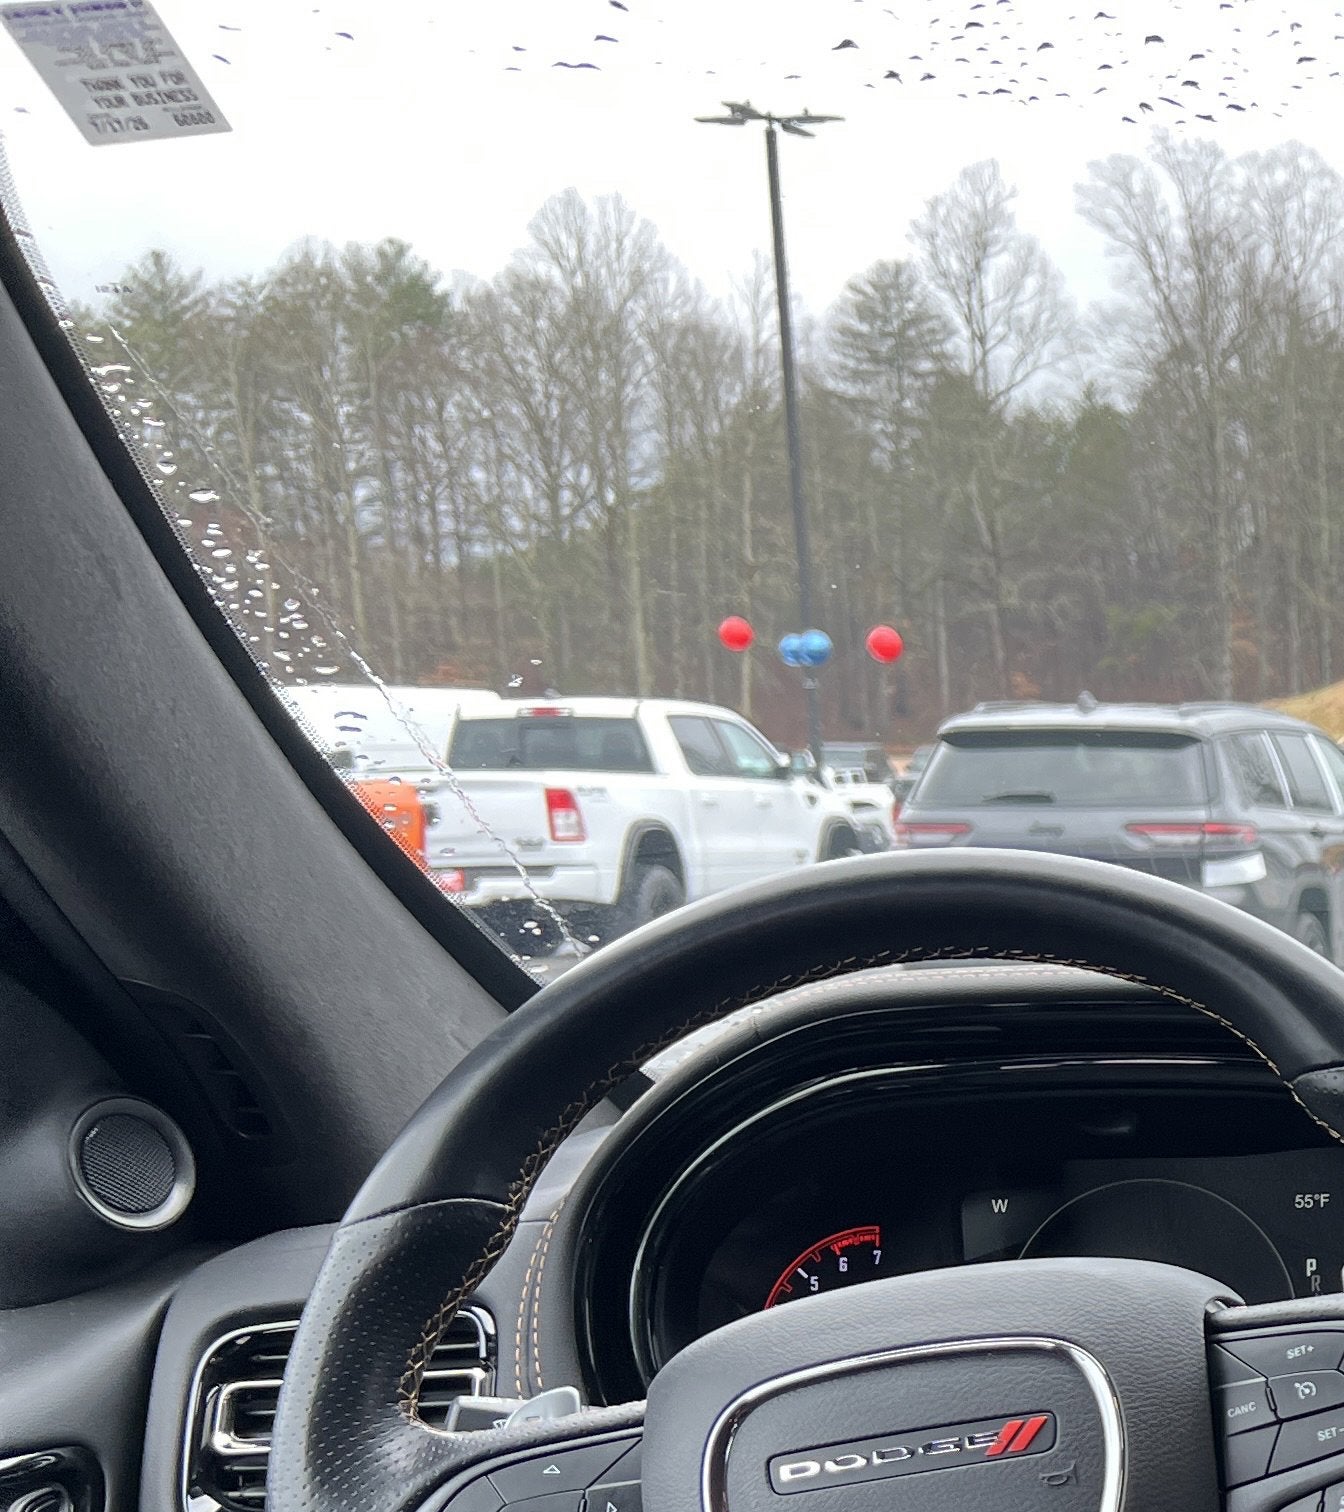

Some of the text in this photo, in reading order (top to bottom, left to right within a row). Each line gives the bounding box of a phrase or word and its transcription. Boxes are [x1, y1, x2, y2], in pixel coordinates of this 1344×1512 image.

[130, 88, 198, 106] BUSINESS
[992, 1199, 1008, 1213] W
[839, 1257, 848, 1272] 6
[873, 1250, 881, 1265] 7
[1306, 1259, 1317, 1276] P
[810, 1276, 819, 1291] 5
[1227, 1401, 1257, 1418] CANC
[779, 1431, 1000, 1482] DODGE
